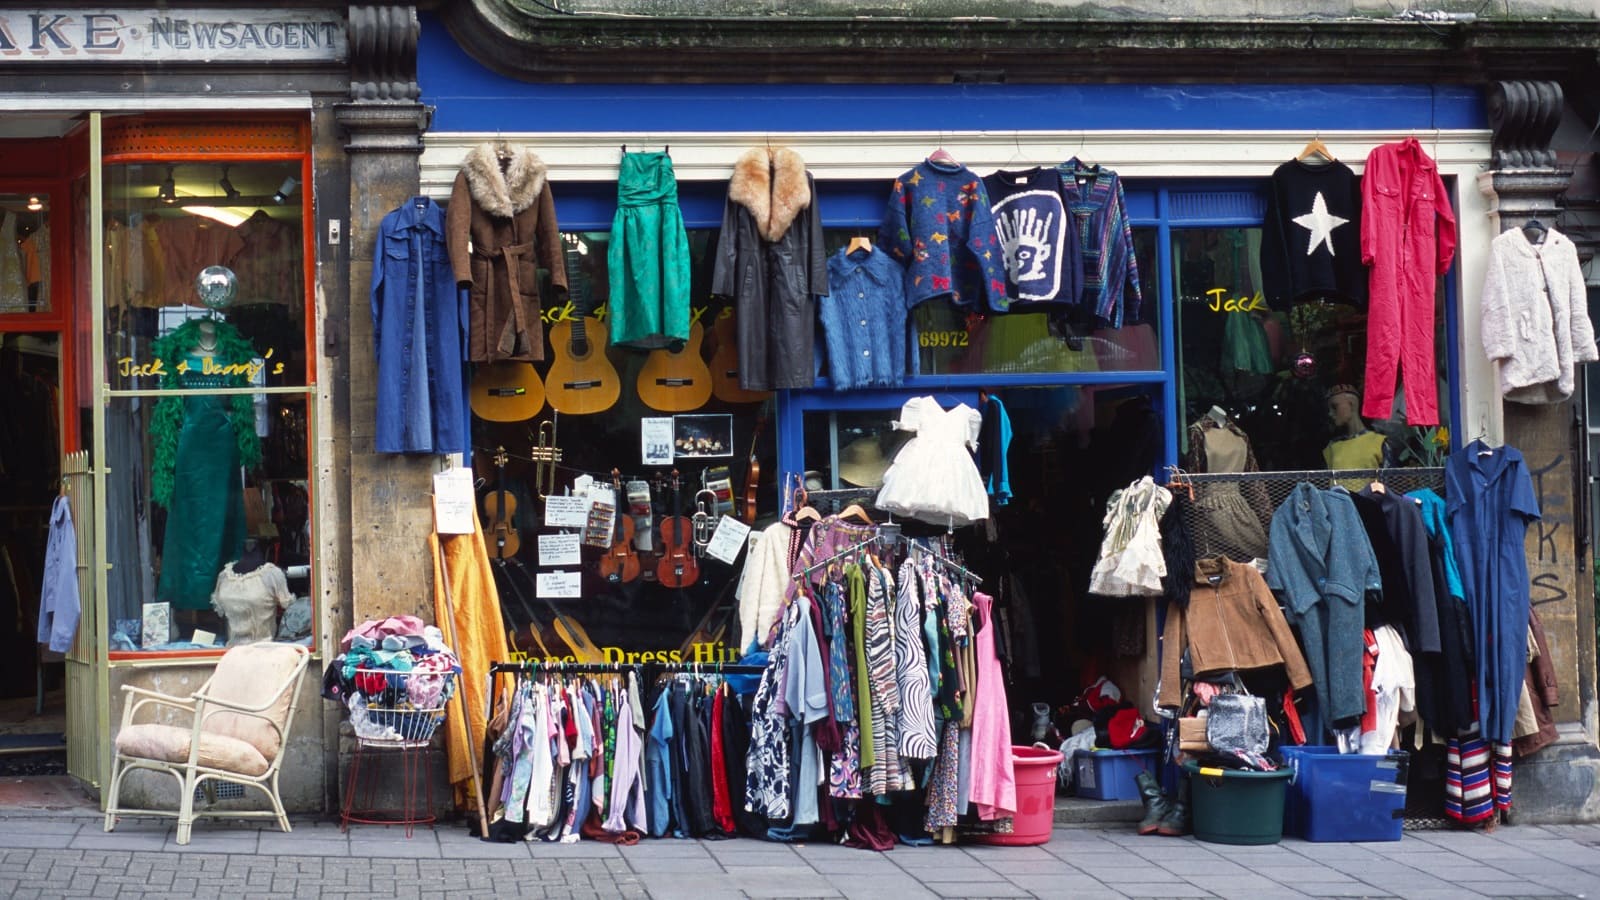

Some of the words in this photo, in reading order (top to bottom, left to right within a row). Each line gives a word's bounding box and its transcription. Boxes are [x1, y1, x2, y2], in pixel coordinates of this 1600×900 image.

[150, 17, 339, 49] NEWSAGENT
[1206, 287, 1269, 312] Jack
[919, 331, 969, 347] 69972
[118, 357, 168, 377] Jack
[601, 647, 682, 665] Dress
[692, 641, 741, 664] Hir
